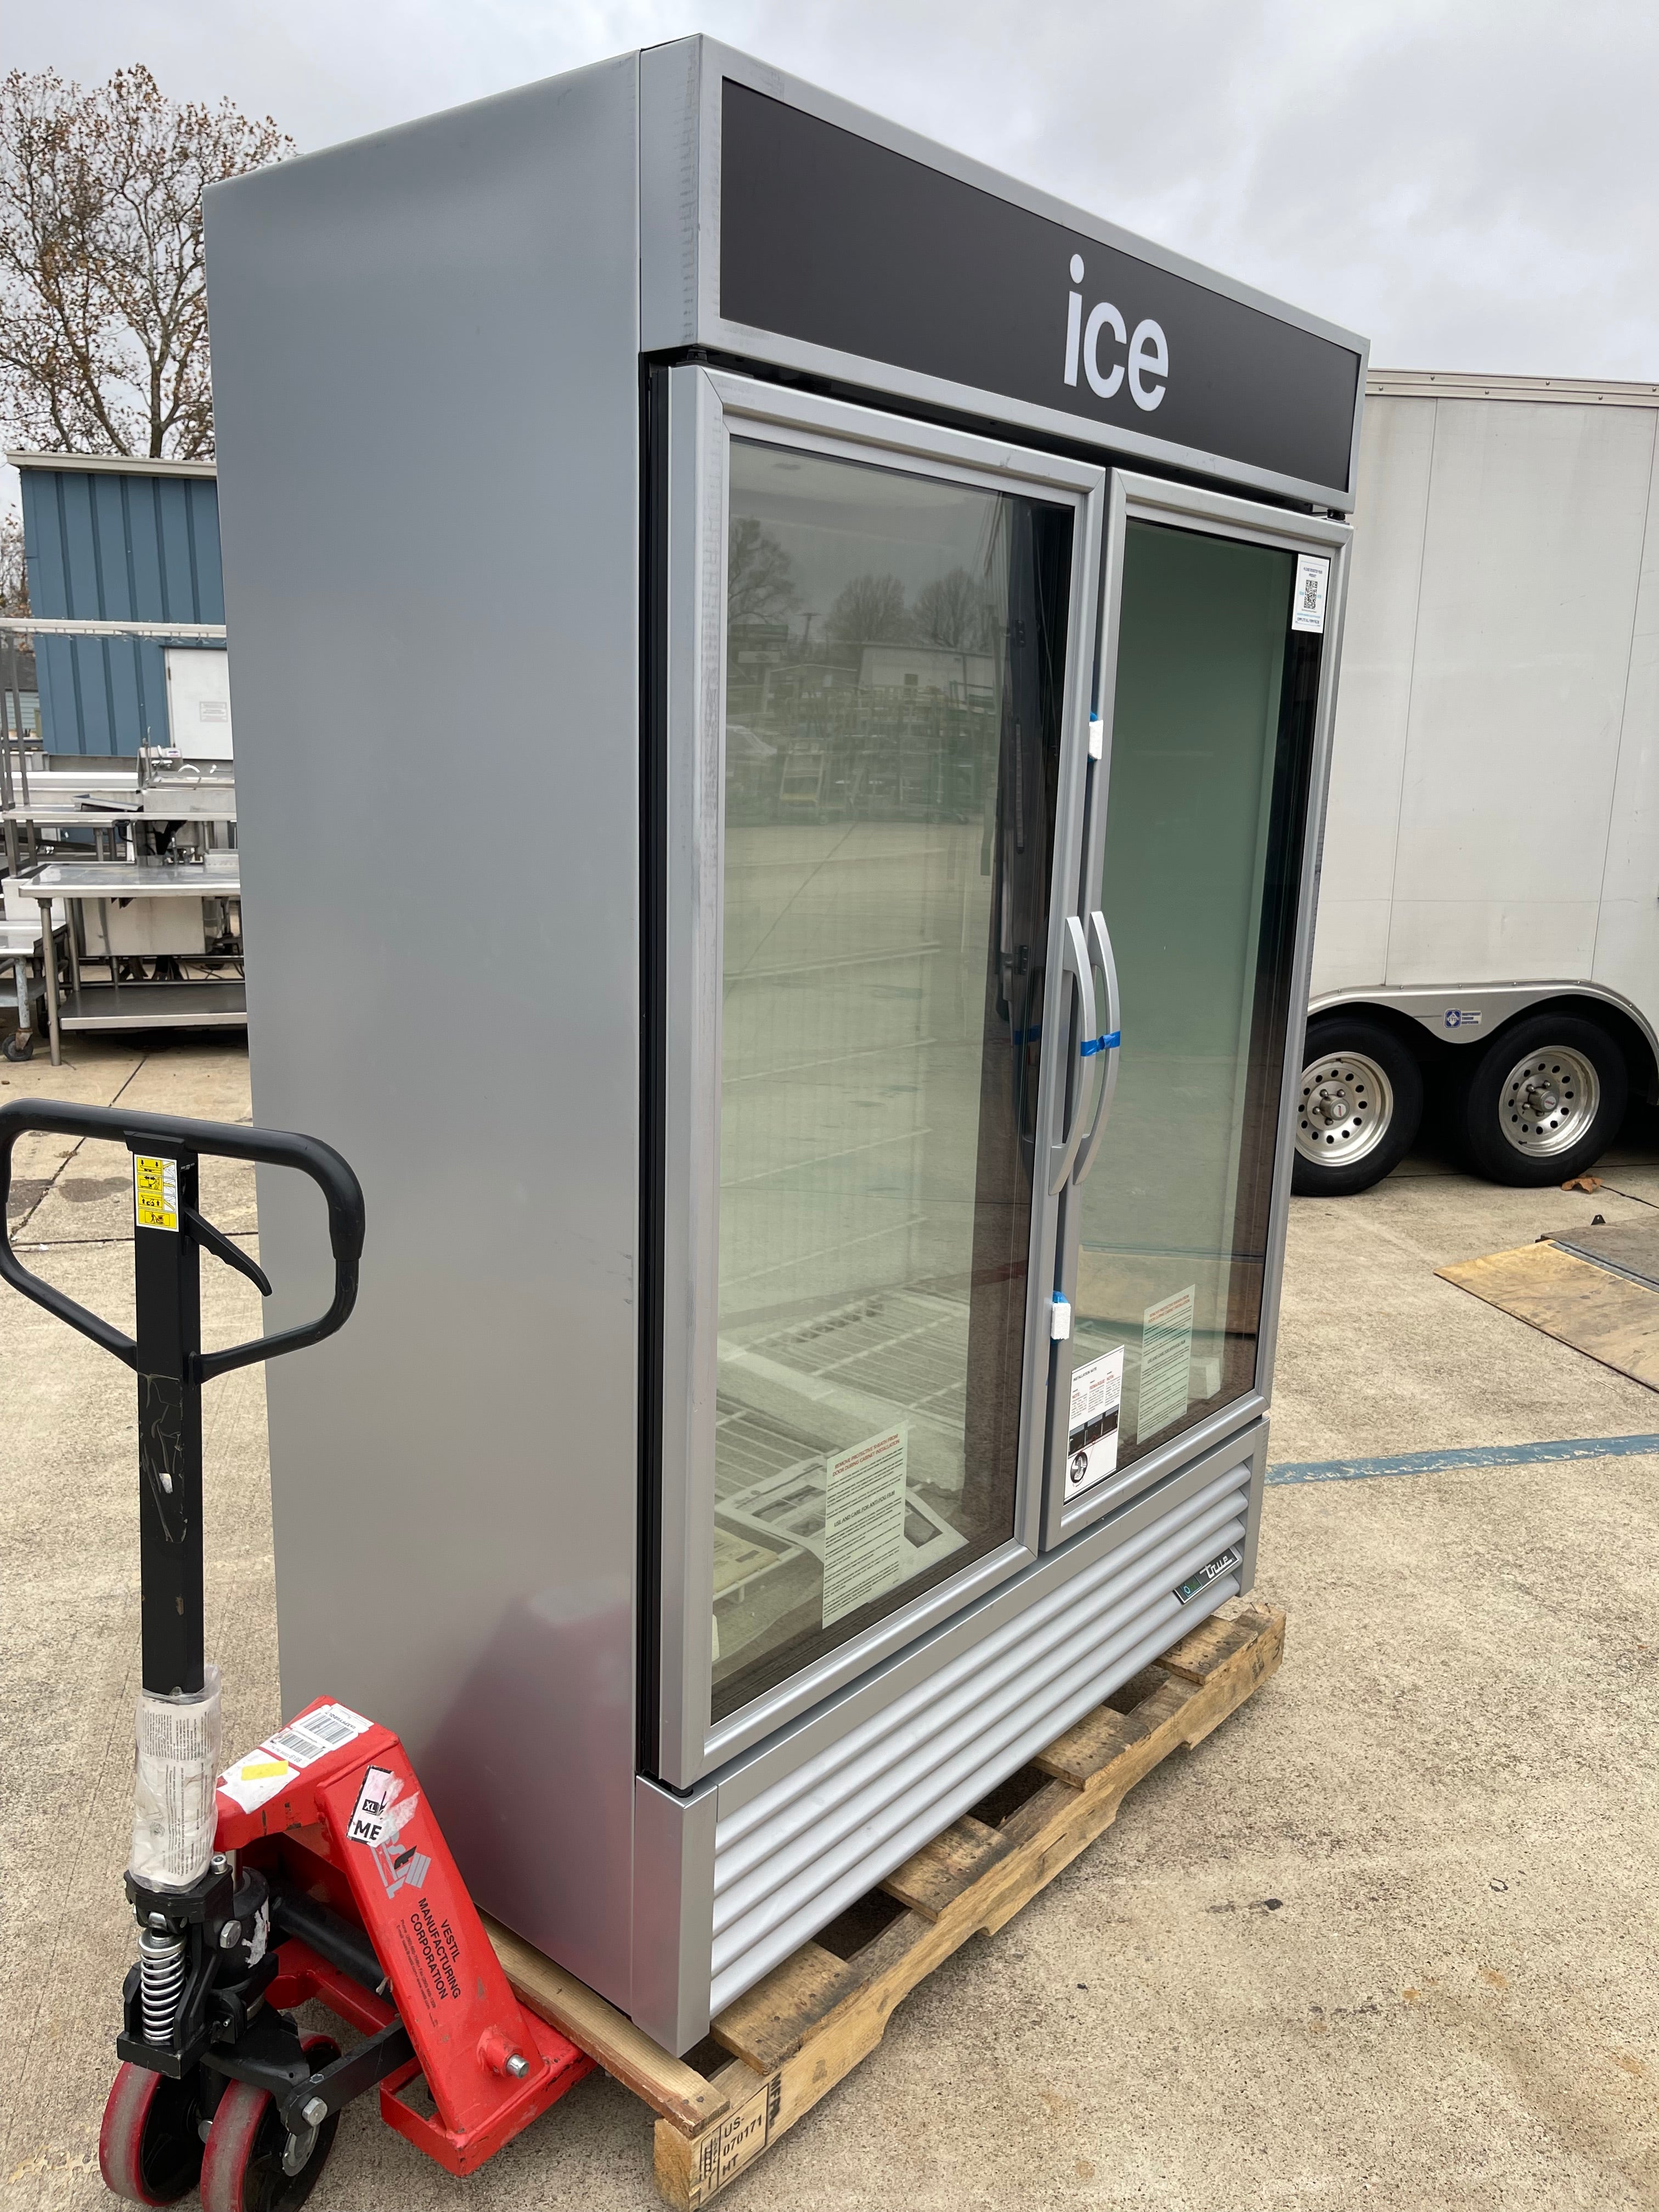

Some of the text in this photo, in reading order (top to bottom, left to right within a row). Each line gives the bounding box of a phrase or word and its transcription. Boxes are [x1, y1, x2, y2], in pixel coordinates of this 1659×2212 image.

[1064, 253, 1169, 411] ice
[364, 1801, 376, 1812] XL
[410, 1913, 448, 1999] CORPORATION
[418, 1898, 461, 1999] MANUFACTURING
[441, 1919, 460, 1962] VESTIL
[724, 2115, 762, 2156] 070171
[723, 2154, 739, 2176] HT
